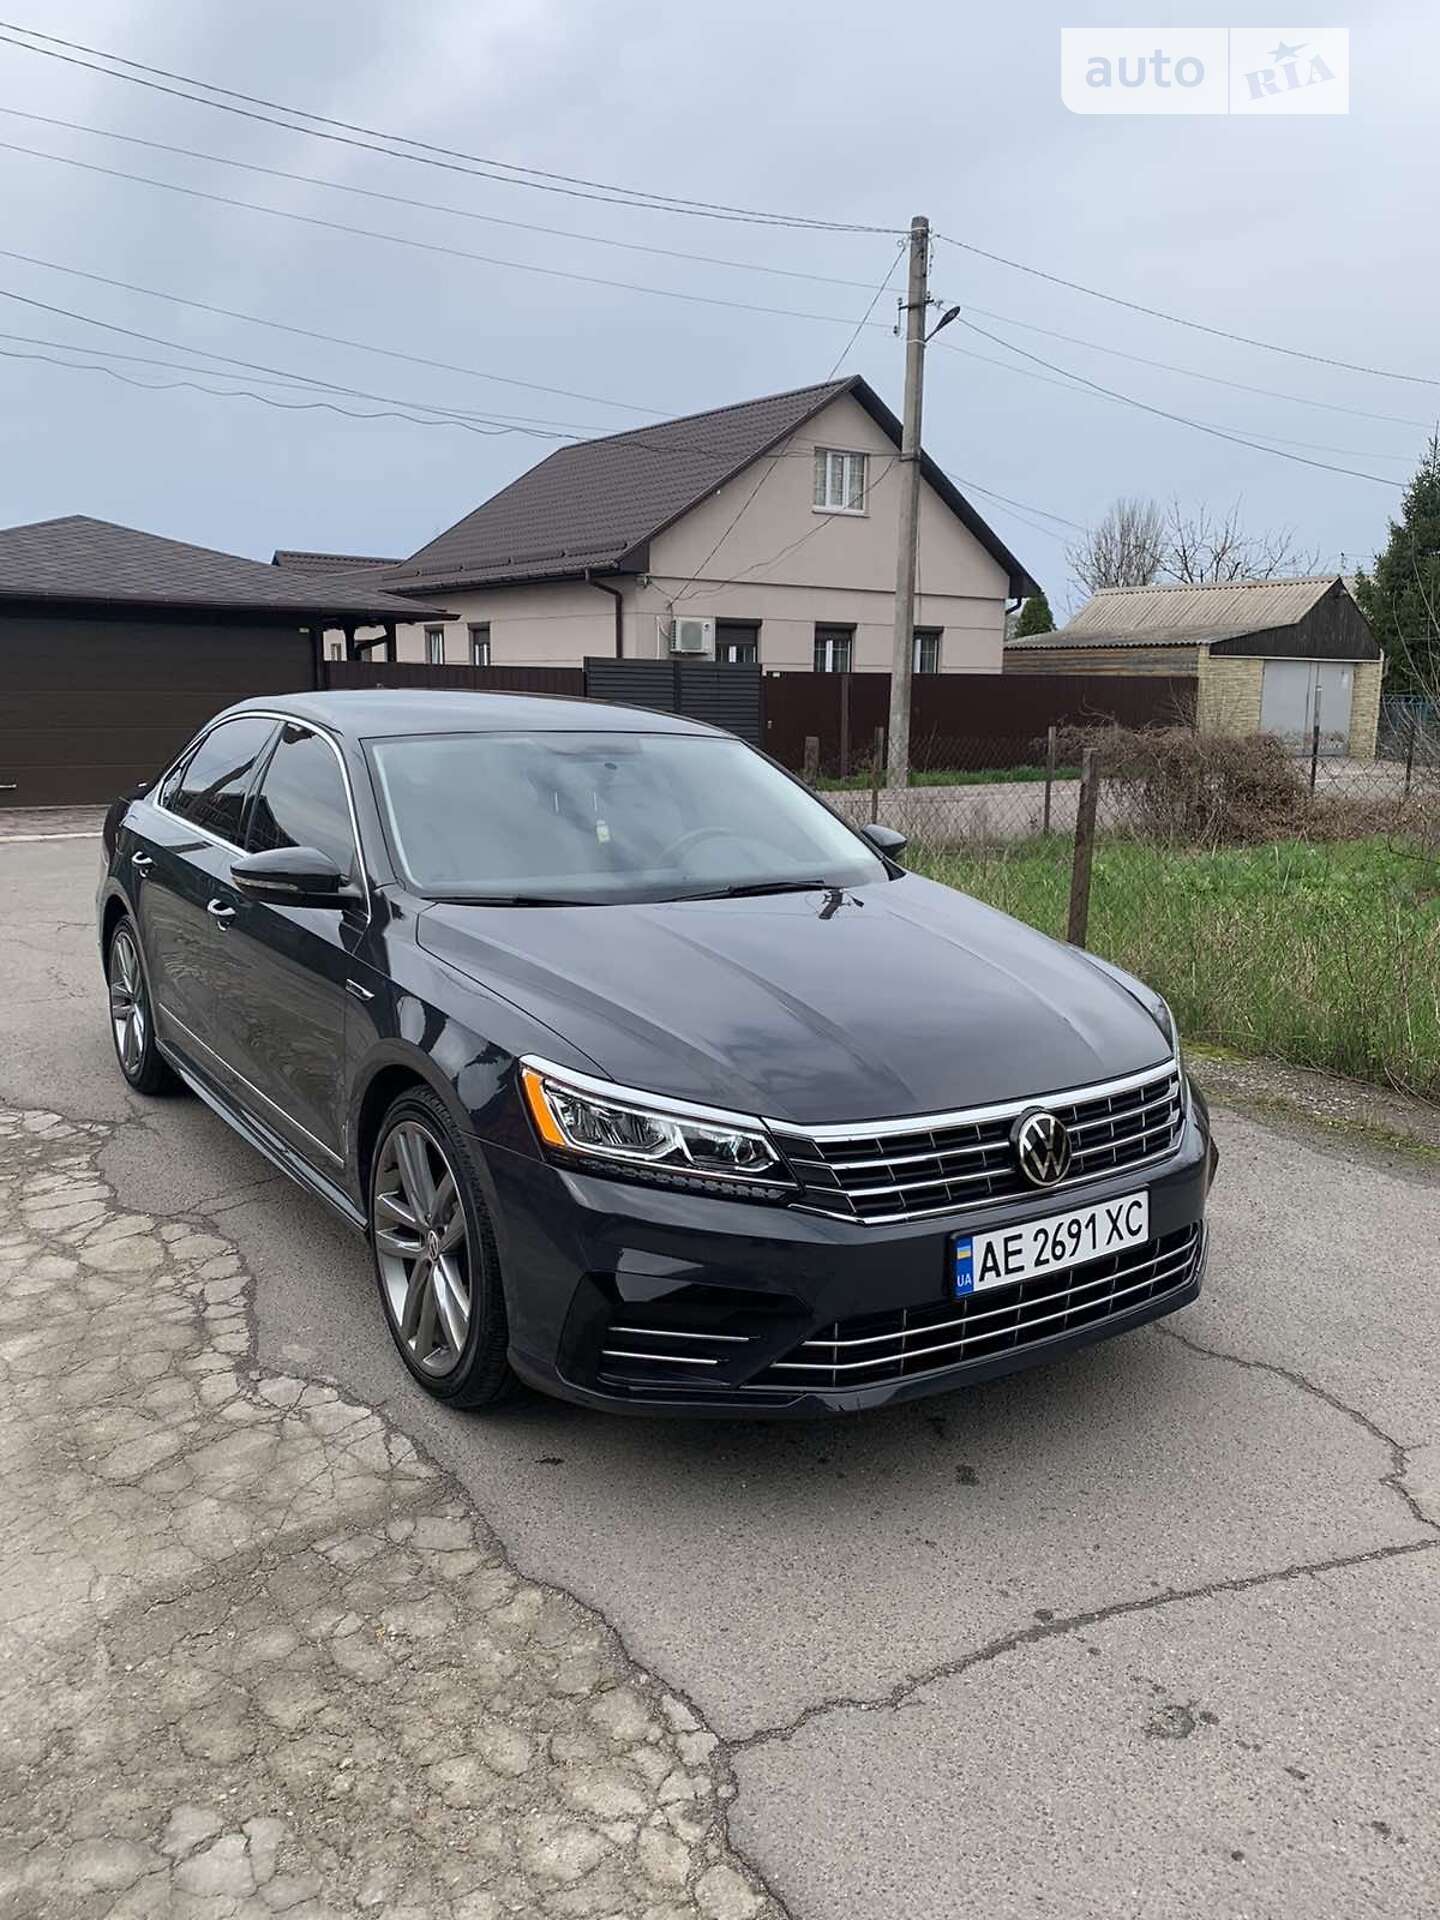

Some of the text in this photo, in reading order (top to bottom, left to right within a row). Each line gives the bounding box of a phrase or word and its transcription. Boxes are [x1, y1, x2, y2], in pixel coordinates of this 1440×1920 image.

[978, 1200, 1143, 1282] AE 2691 XC
[957, 1273, 972, 1287] UA
